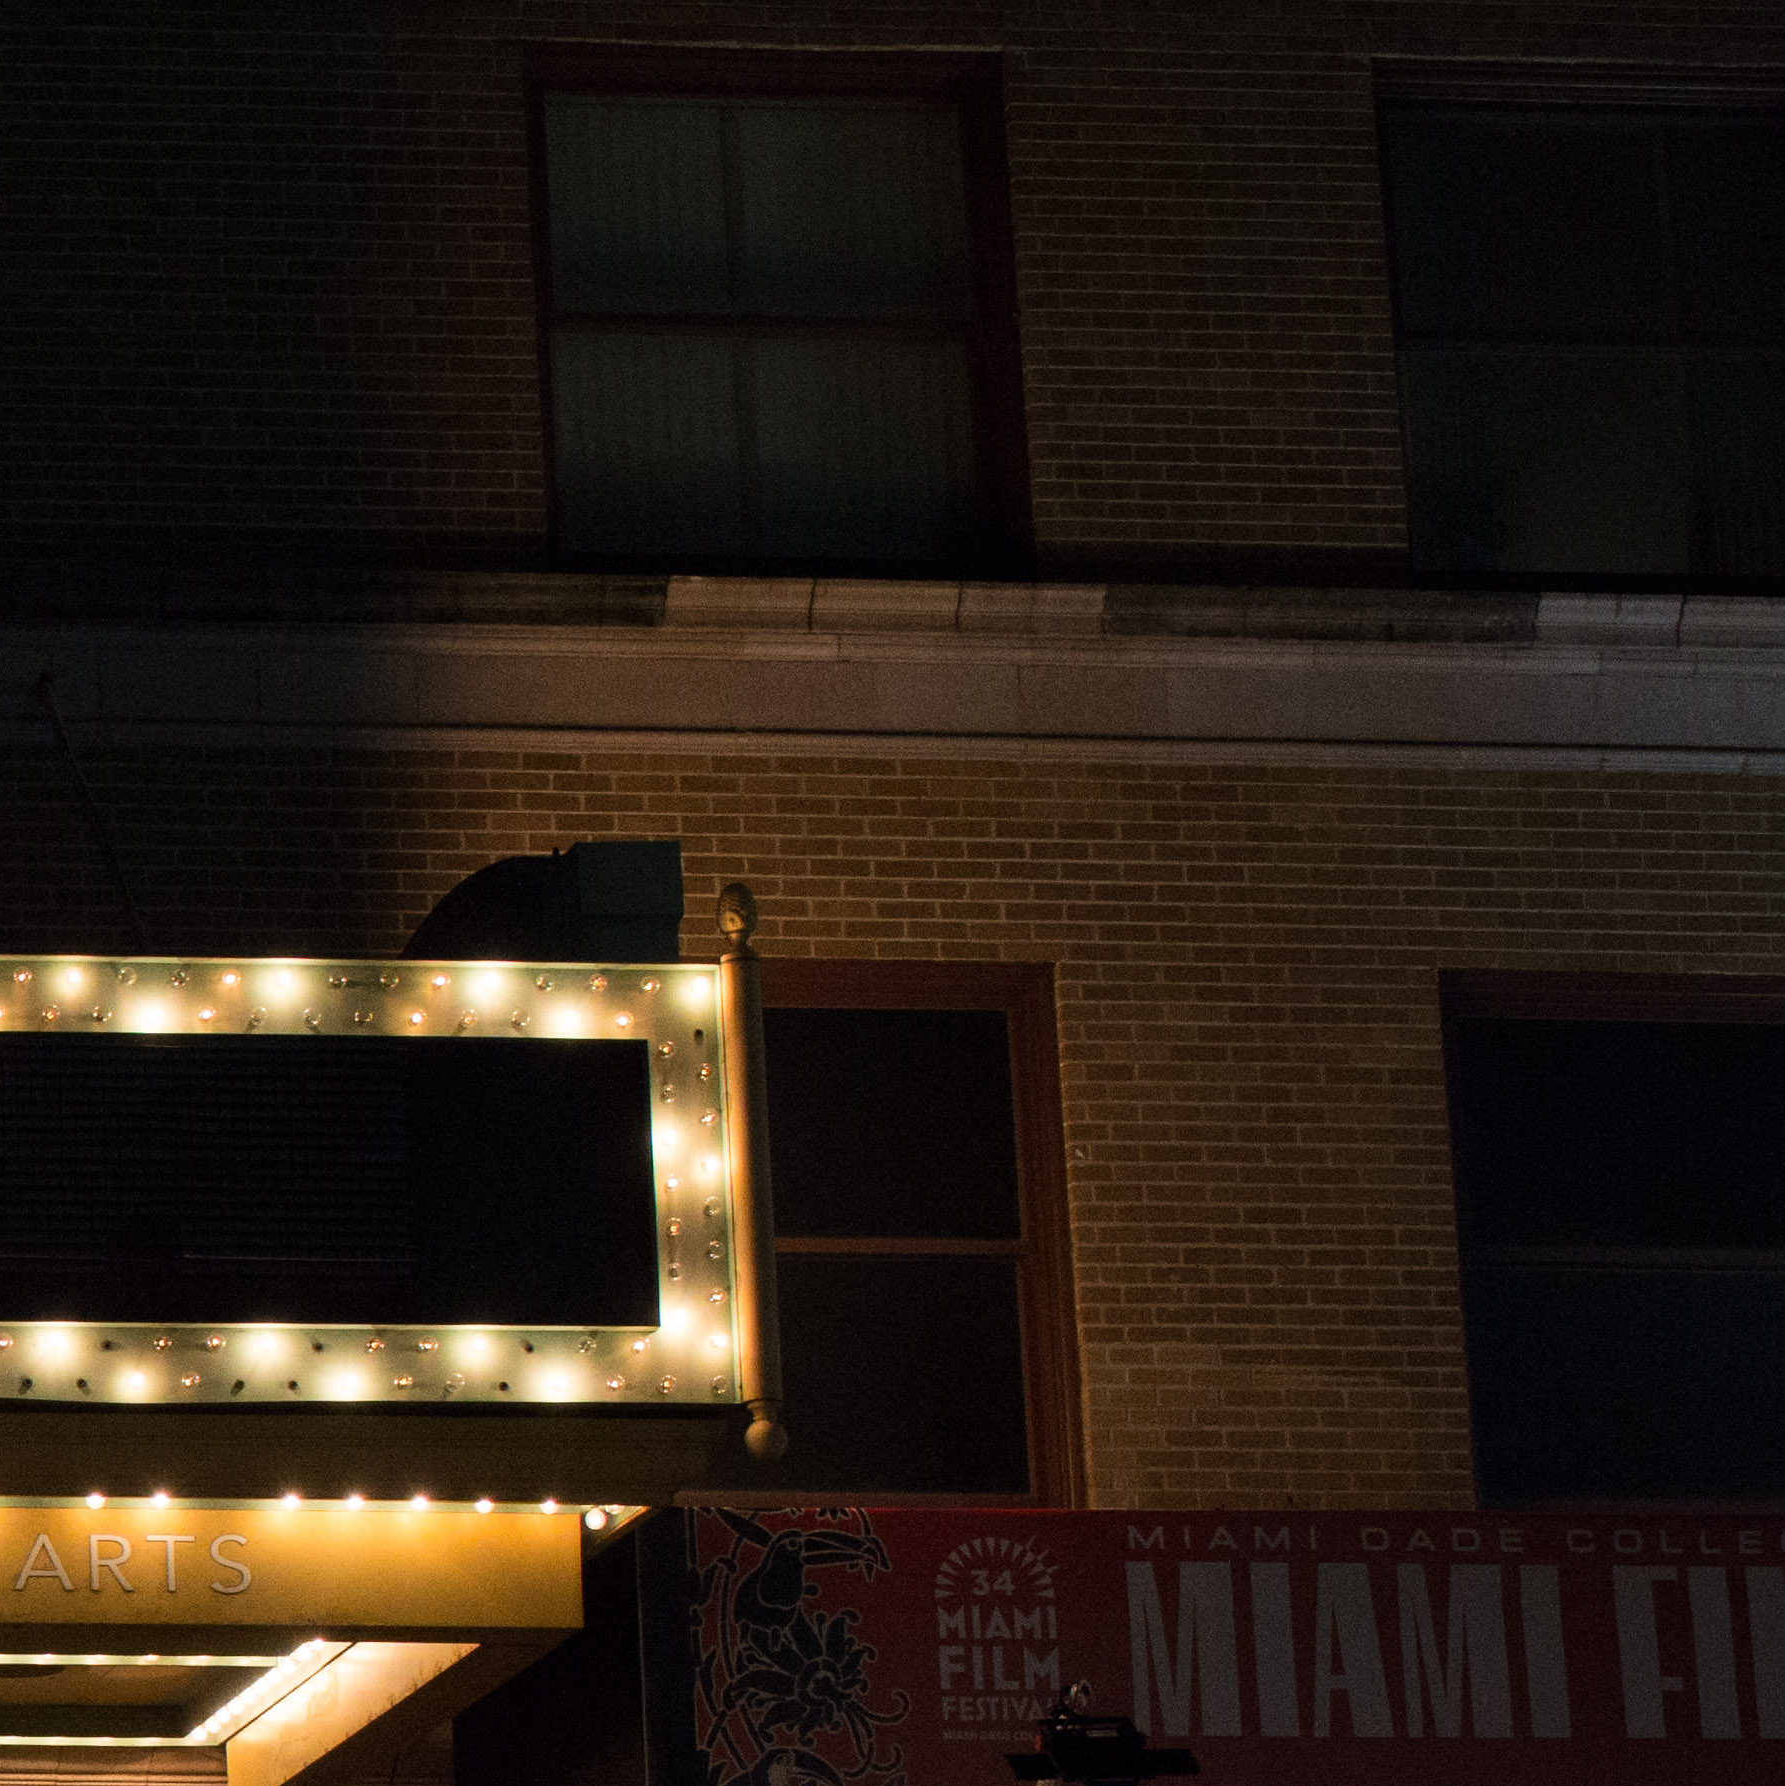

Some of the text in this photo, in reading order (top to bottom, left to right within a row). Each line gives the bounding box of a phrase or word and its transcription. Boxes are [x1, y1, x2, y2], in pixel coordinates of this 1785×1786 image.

[1127, 1525, 1785, 1555] MIAMI DADE COLLE
[15, 1531, 253, 1596] ARTS
[970, 1569, 1016, 1597] 34
[937, 1605, 1058, 1640] MIAMI
[1125, 1560, 1572, 1740] MIAMI
[938, 1645, 1060, 1691] FILM
[941, 1696, 1053, 1722] FESTIVA
